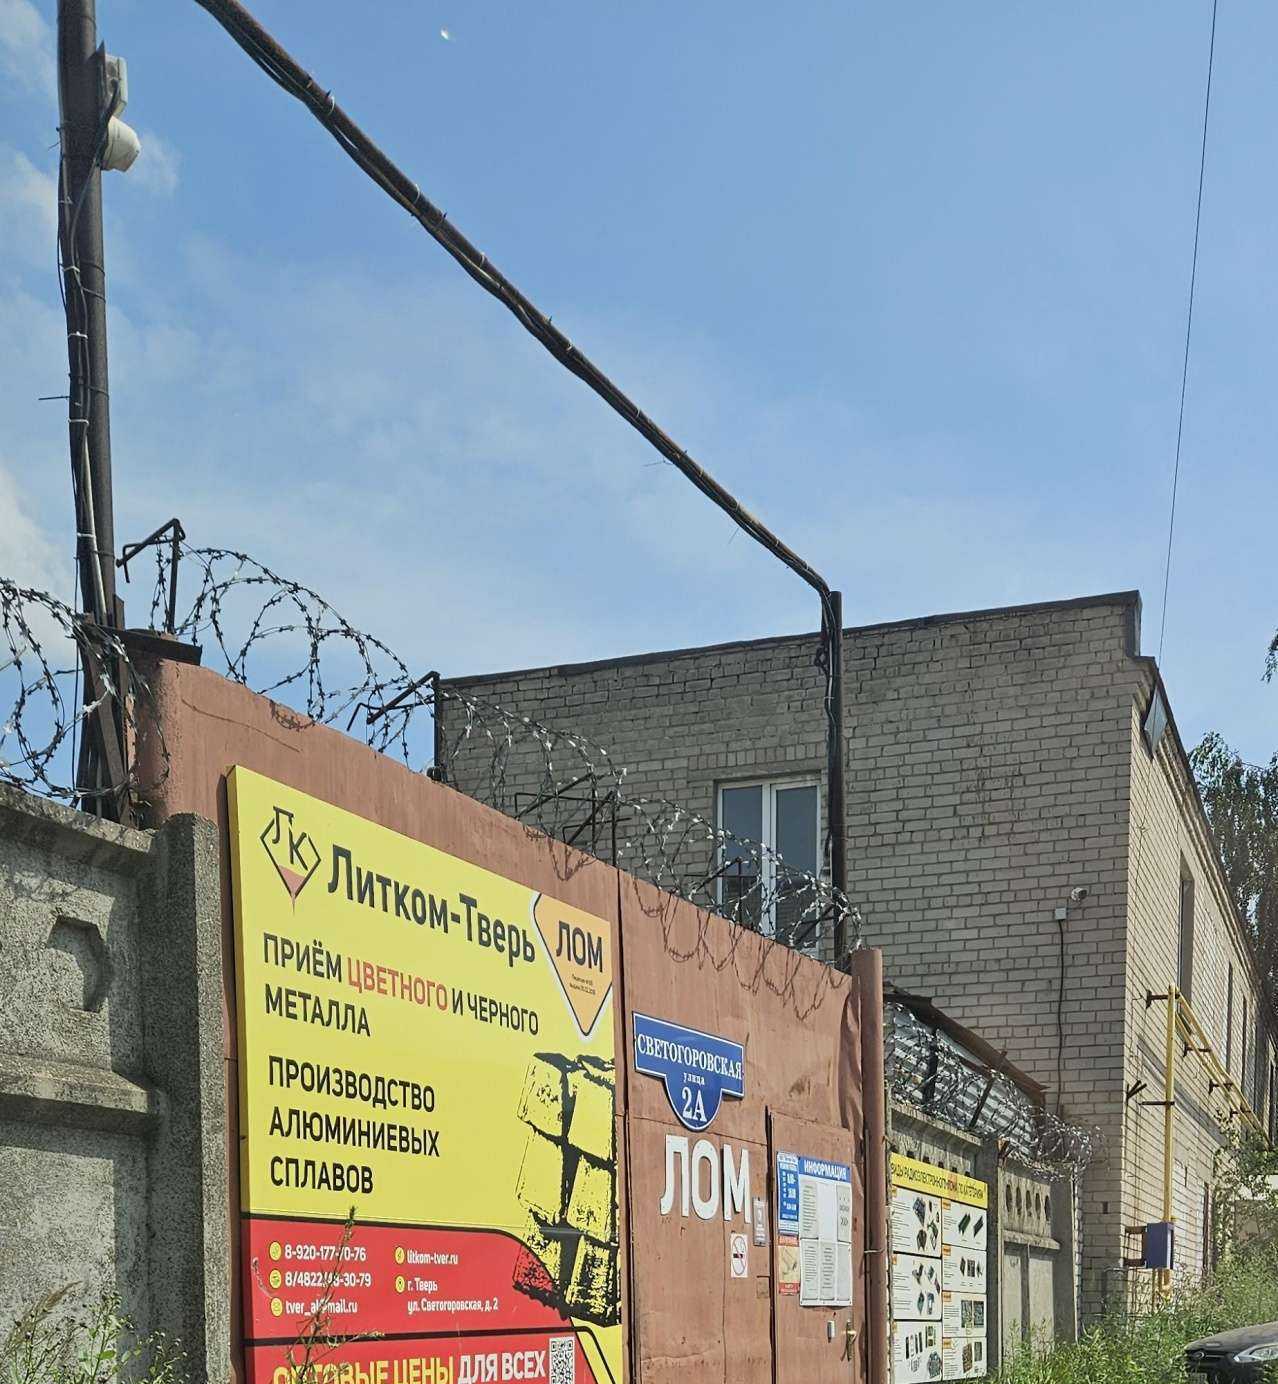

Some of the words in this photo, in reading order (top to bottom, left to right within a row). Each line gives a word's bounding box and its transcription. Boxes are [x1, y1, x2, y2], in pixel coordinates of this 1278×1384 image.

[327, 844, 536, 967] Литком-Тверь
[556, 920, 603, 973] ЛОМ
[263, 932, 342, 983] ПРИЁМ
[346, 956, 448, 1012] ЦВЕТНОГО
[451, 987, 464, 1017] И
[467, 992, 539, 1036] ЧЕРНОГО
[265, 984, 371, 1037] МЕТАЛЛА
[637, 1033, 742, 1080] СВЕТОГОРОВСКАЯ
[268, 1055, 435, 1113] ПРОИЗВОДСТВО
[683, 1072, 705, 1086] улица
[682, 1086, 707, 1122] 2А
[269, 1106, 440, 1158] АЛЮМИНИЕВЫХ
[270, 1155, 374, 1195] СПЛАВОВ
[660, 1134, 751, 1224] ЛОМ
[804, 1159, 847, 1180] ИНФОРМАЦИЯ
[407, 1249, 458, 1264] litkom-tver.ru
[407, 1280, 413, 1291] г.
[414, 1277, 438, 1293] Тверь
[407, 1300, 420, 1315] ул.
[421, 1298, 484, 1314] Светогоровская,
[484, 1300, 492, 1312] д.
[493, 1296, 499, 1310] 2
[501, 1350, 546, 1381] ВСЕХ
